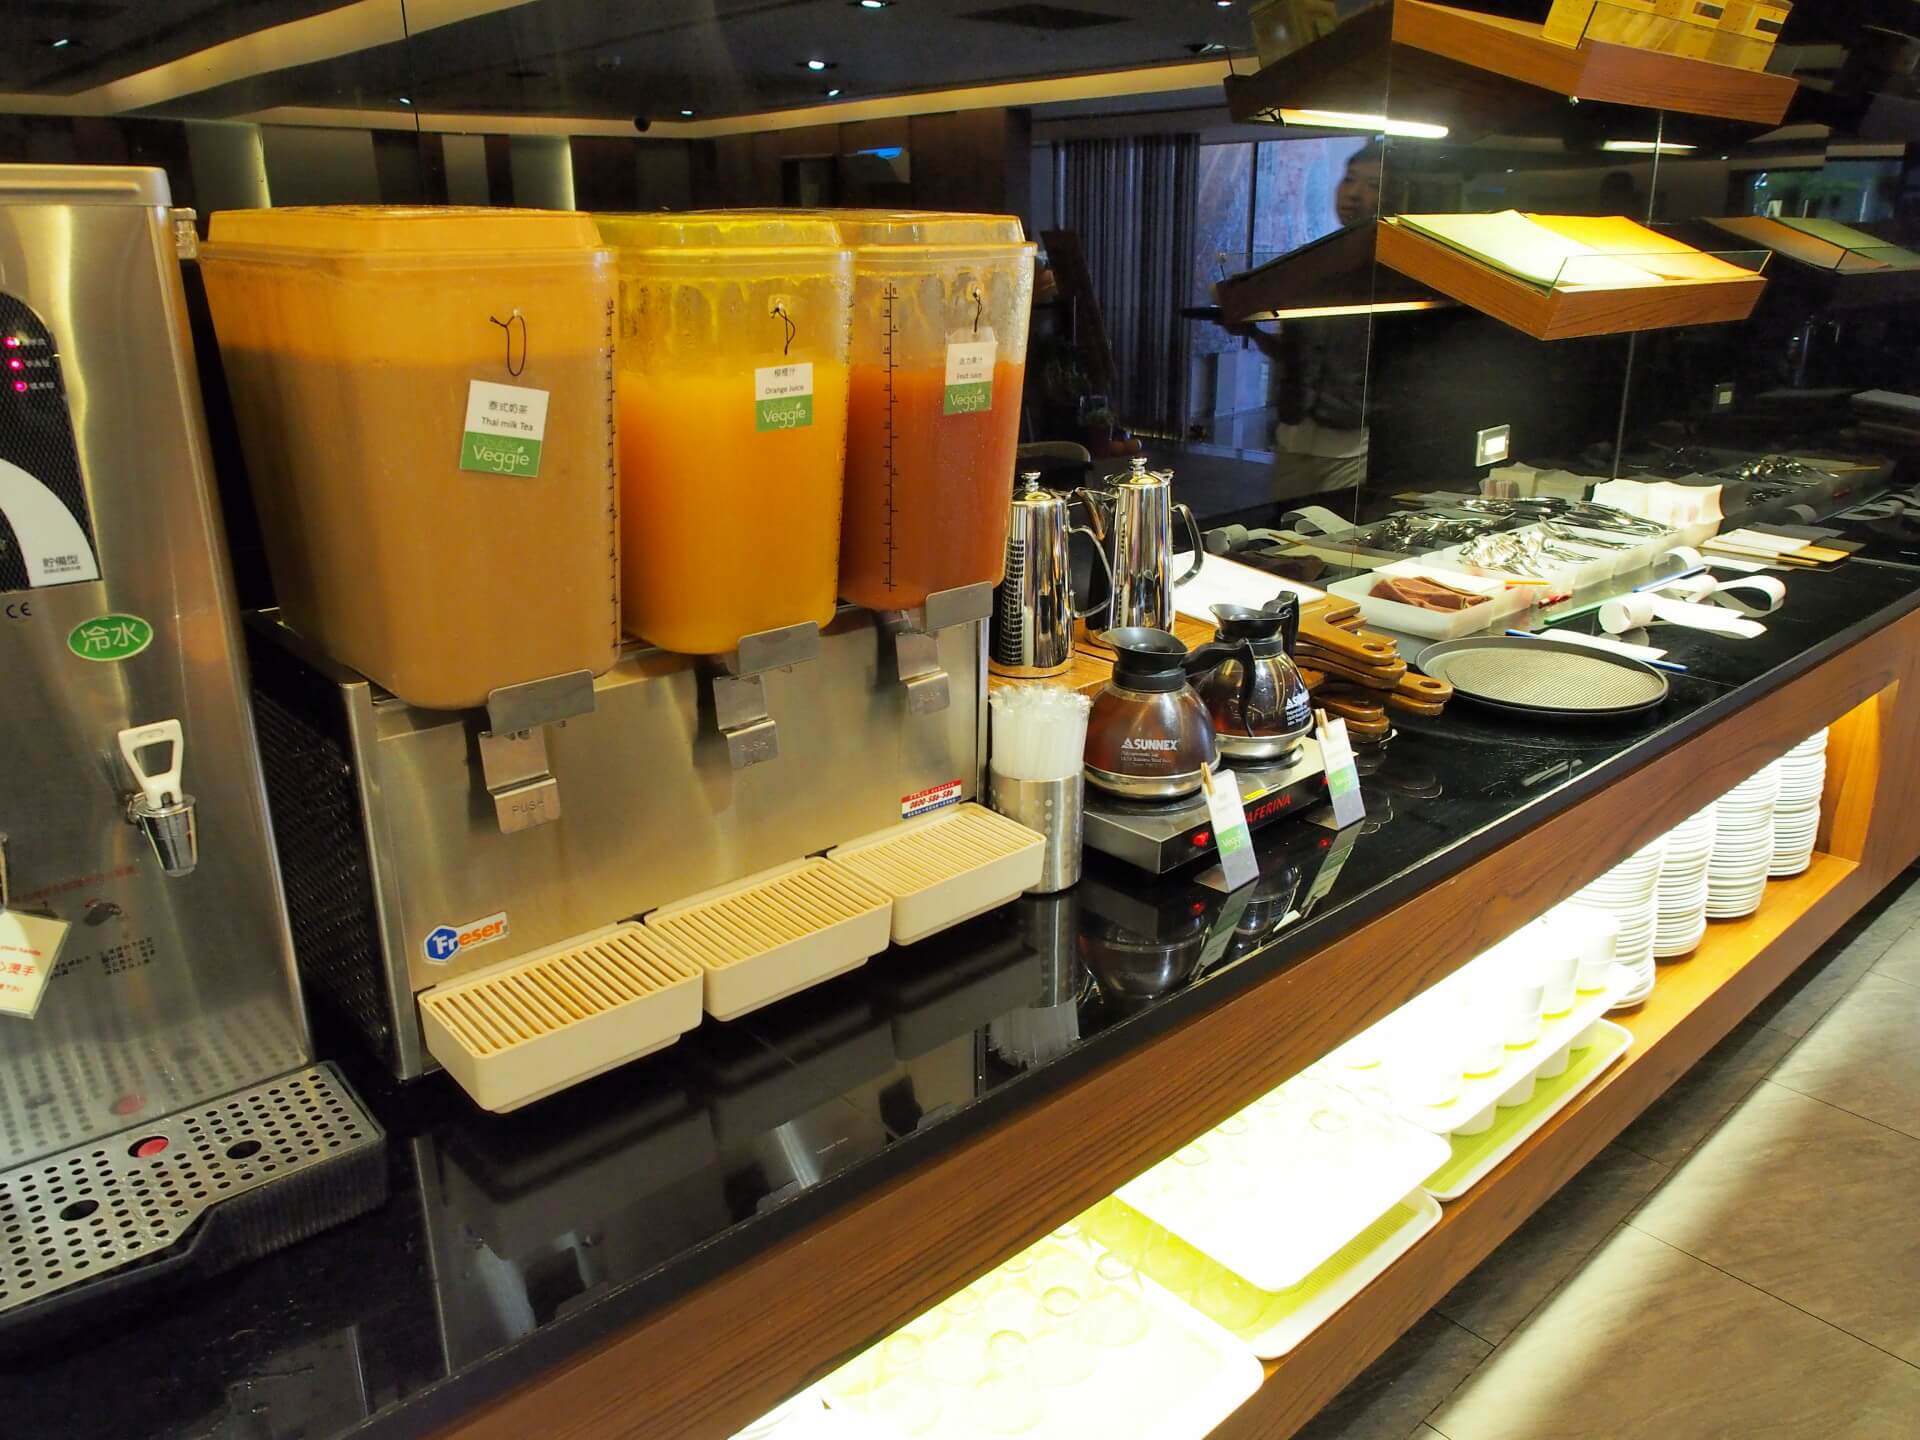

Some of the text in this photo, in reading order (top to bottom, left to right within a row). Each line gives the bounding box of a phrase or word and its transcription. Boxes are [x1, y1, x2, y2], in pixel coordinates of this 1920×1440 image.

[950, 386, 985, 412] Veggie
[481, 416, 534, 432] Thai milk Tea
[762, 401, 807, 429] Veggie
[472, 443, 530, 473] Veggie
[80, 622, 141, 653] 冷水
[1133, 738, 1178, 752] SUNNEX
[1245, 793, 1293, 824] AFERINA
[432, 919, 504, 955] Freser
